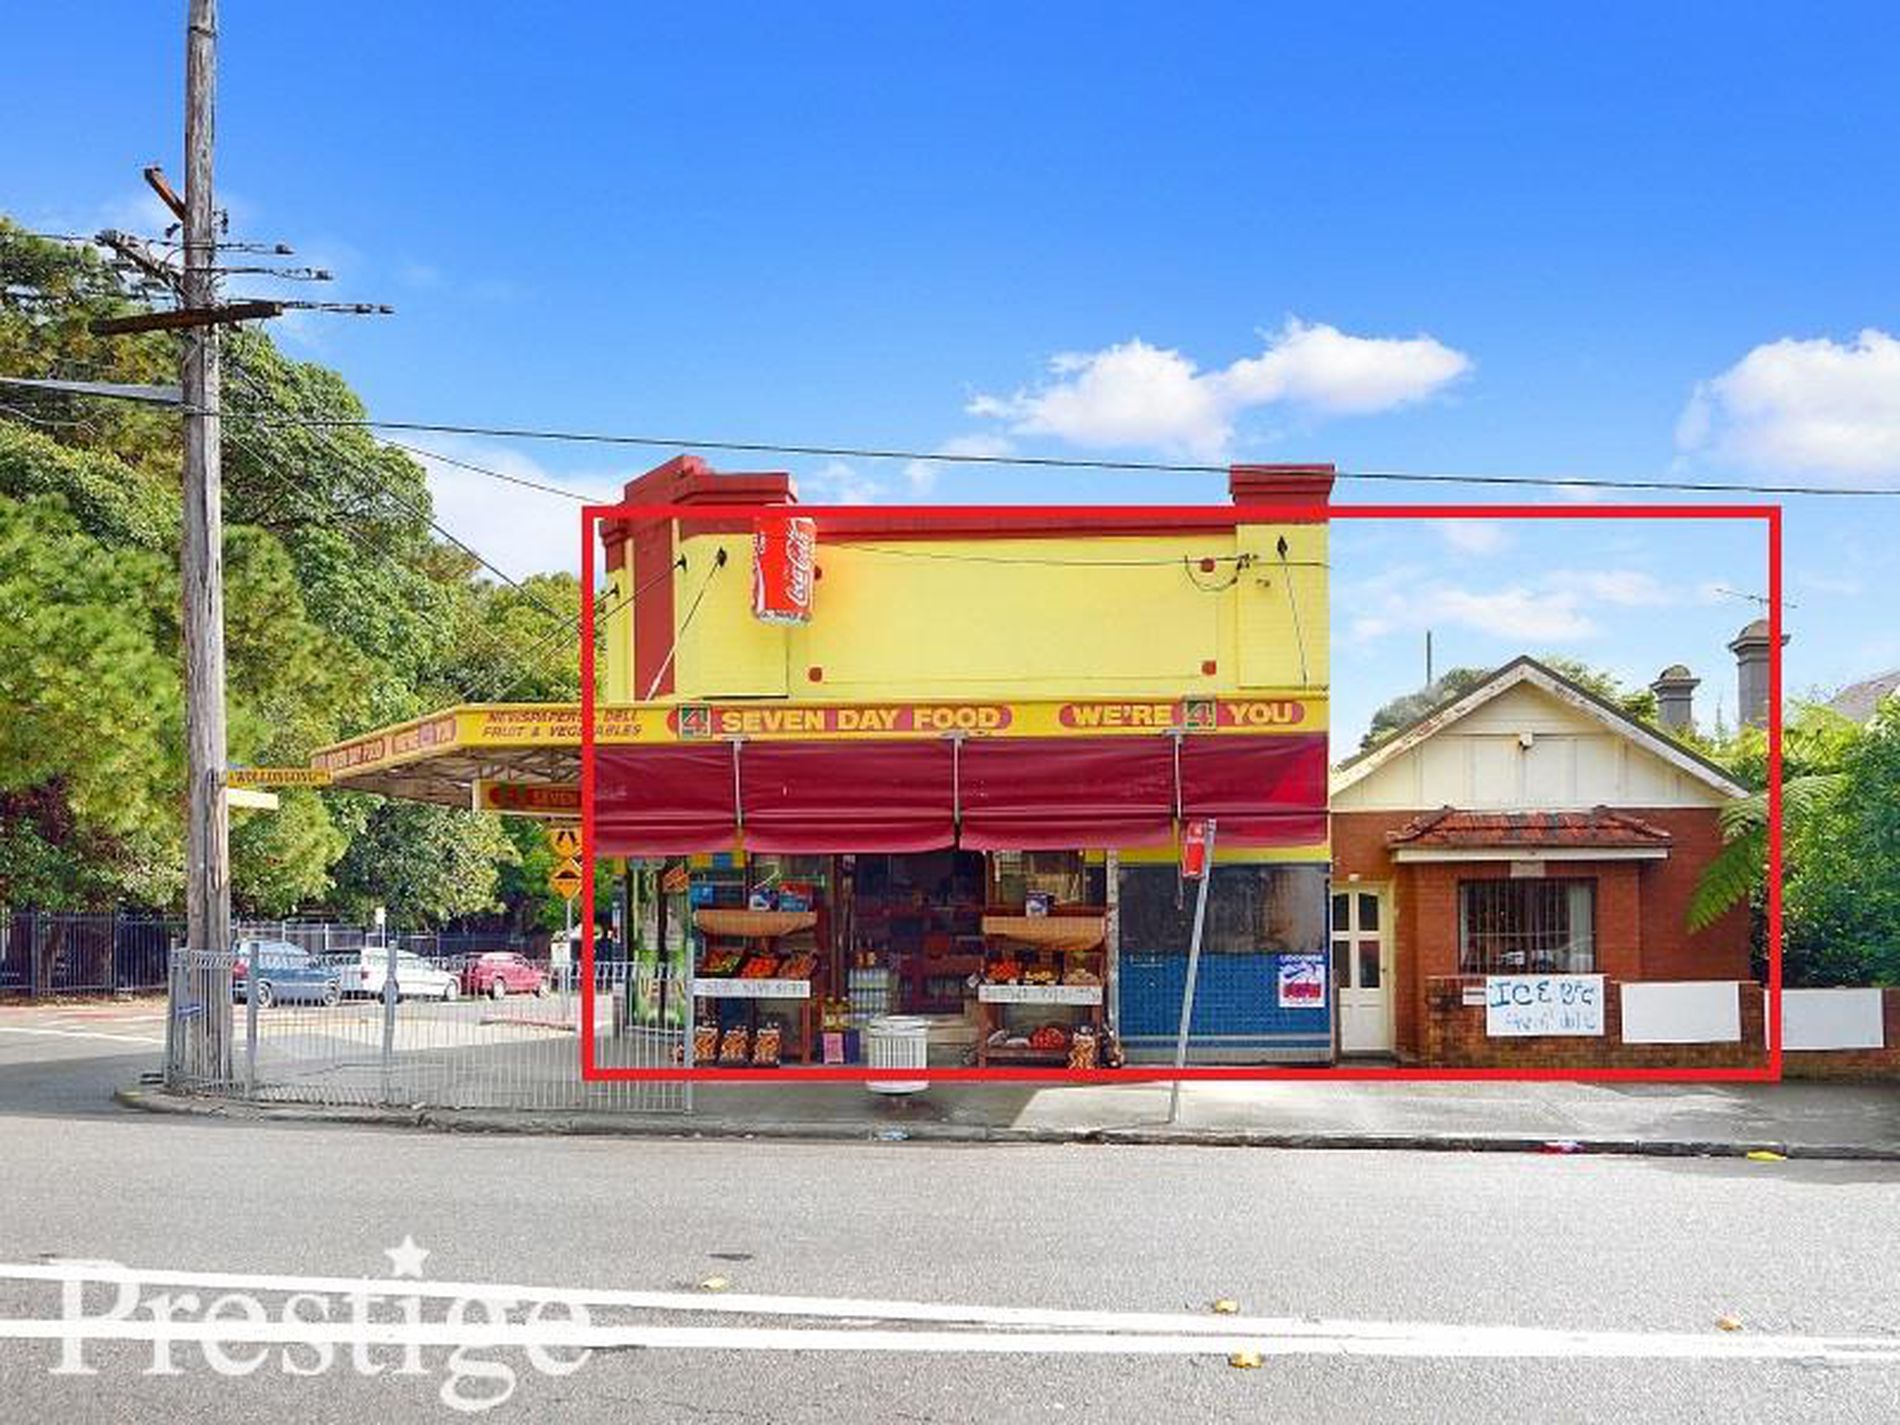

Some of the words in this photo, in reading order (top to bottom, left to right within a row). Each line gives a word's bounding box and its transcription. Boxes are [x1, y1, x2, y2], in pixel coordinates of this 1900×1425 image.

[721, 710, 826, 732] SEVEN
[835, 709, 899, 731] DAY
[912, 707, 1001, 730] FOOD
[1072, 704, 1173, 726] WE'RE
[1228, 703, 1293, 725] YOU
[482, 724, 525, 738] FRUIT
[1489, 979, 1553, 1008] ICE
